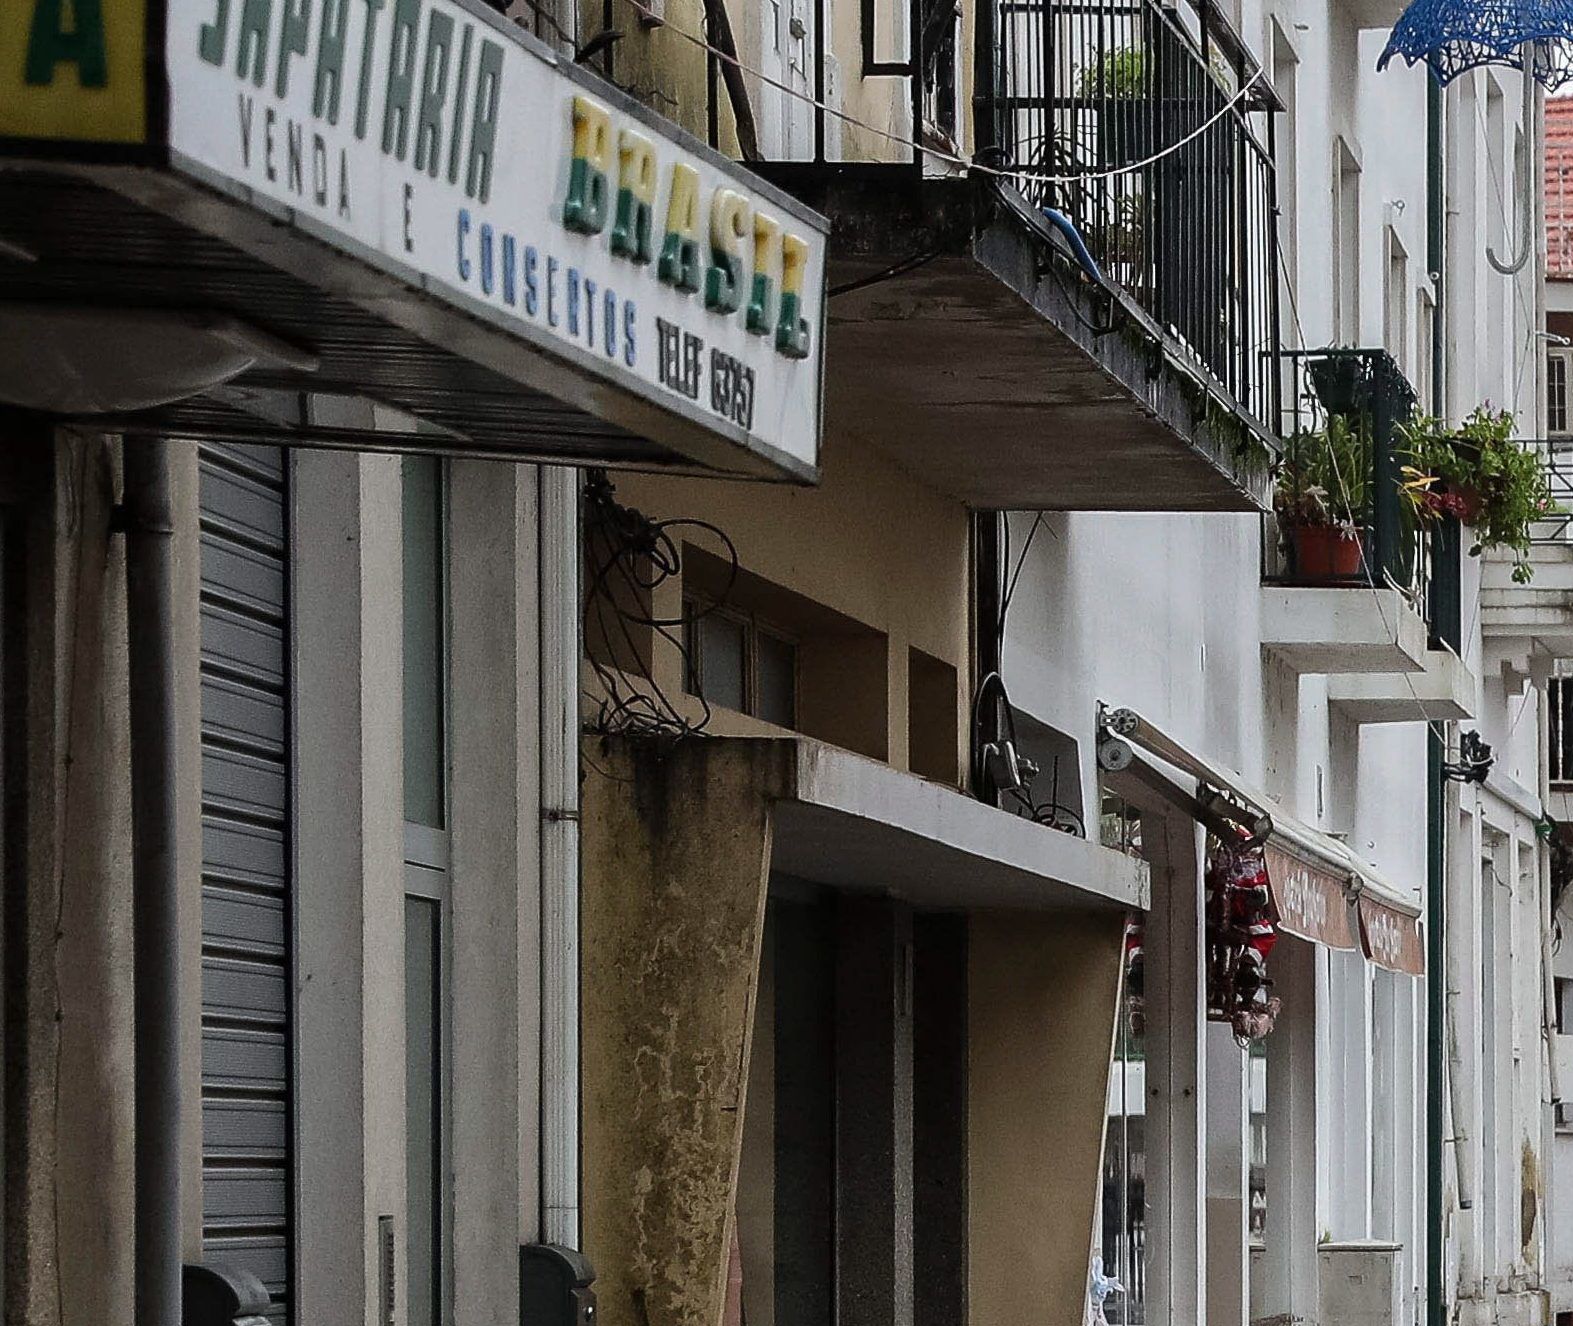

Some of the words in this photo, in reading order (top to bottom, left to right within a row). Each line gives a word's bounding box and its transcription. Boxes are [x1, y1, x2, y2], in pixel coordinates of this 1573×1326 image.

[239, 92, 351, 218] VENDA
[403, 181, 414, 253] E
[457, 208, 637, 368] CONSERTOS
[562, 95, 811, 359] BRASIL
[656, 316, 704, 401] TELEF
